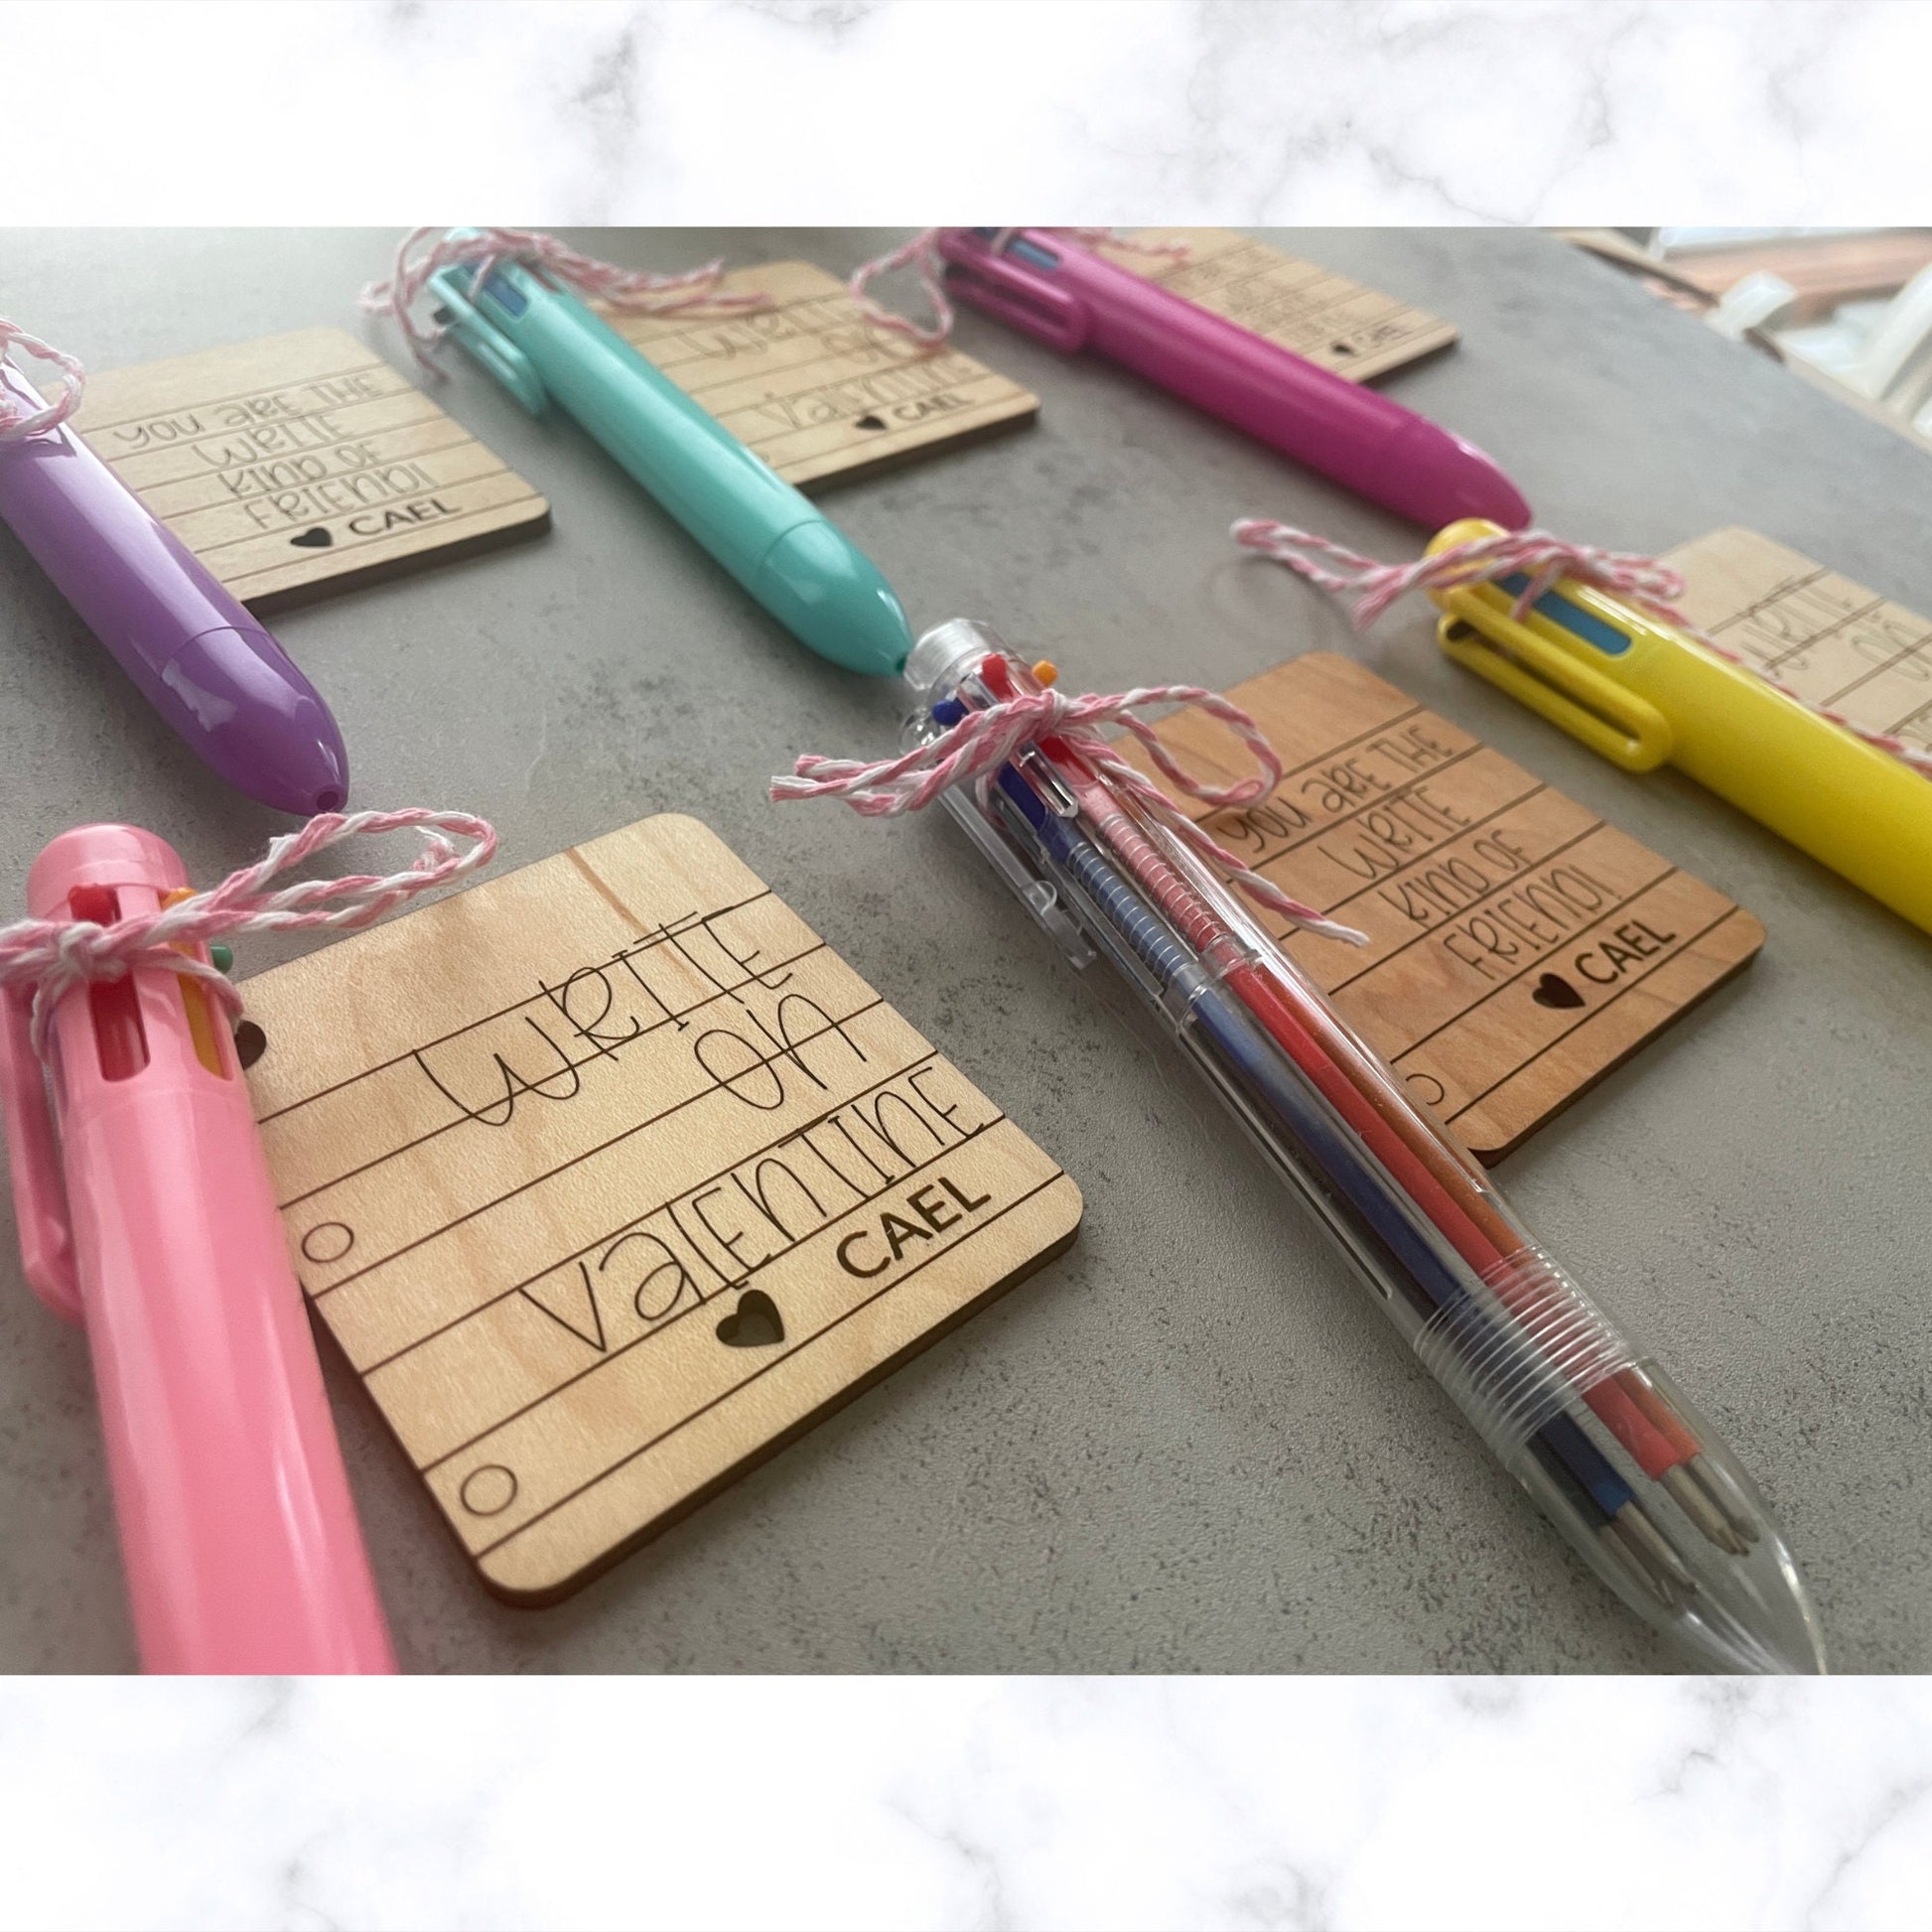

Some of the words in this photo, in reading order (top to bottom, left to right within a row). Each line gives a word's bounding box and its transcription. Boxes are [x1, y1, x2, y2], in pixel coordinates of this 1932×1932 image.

[112, 412, 207, 449] YOU
[216, 454, 328, 500] KIND
[348, 496, 463, 536] CAEL
[1215, 796, 1313, 854] YOU
[1301, 757, 1391, 814] ARE
[1364, 724, 1453, 773] THE
[1315, 784, 1472, 881] WRITE
[1376, 856, 1491, 929] KIND
[1472, 829, 1532, 872] OF
[1574, 919, 1678, 985] CAEL
[412, 905, 793, 1127] WRITE
[693, 993, 868, 1111] ON
[517, 1065, 986, 1353] VALENTINE
[835, 1175, 993, 1279] CAEL
